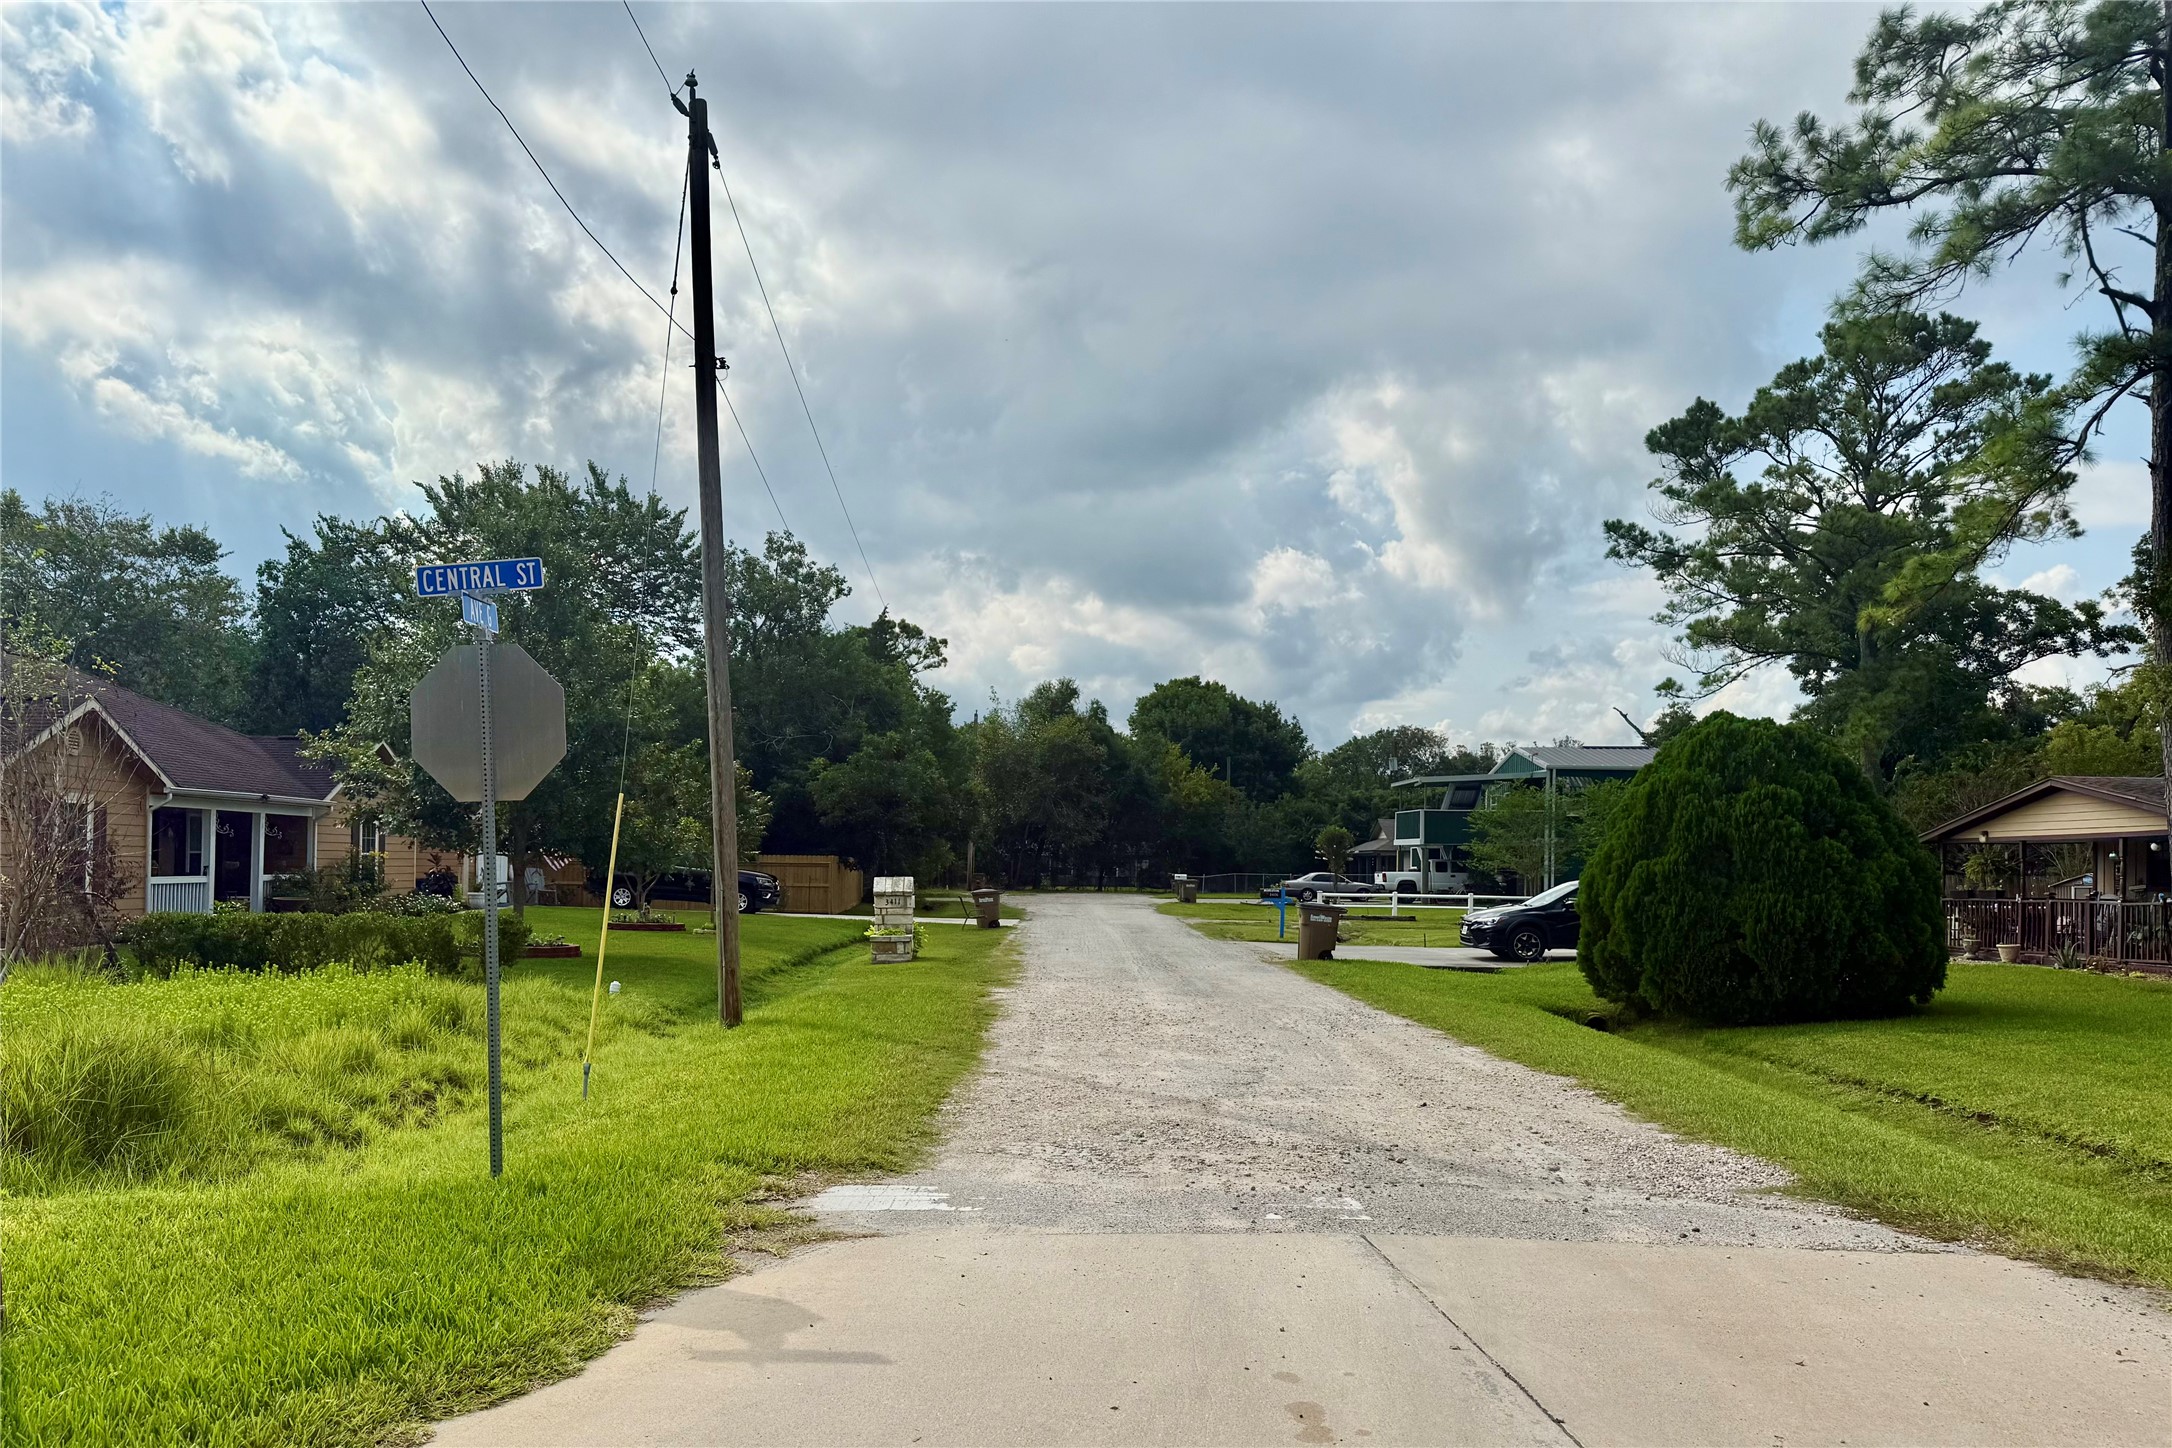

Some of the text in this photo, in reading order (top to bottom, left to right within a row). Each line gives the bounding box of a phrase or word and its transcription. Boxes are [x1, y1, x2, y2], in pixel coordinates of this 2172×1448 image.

[422, 562, 536, 593] CENTRAL ST
[470, 598, 484, 624] AVE
